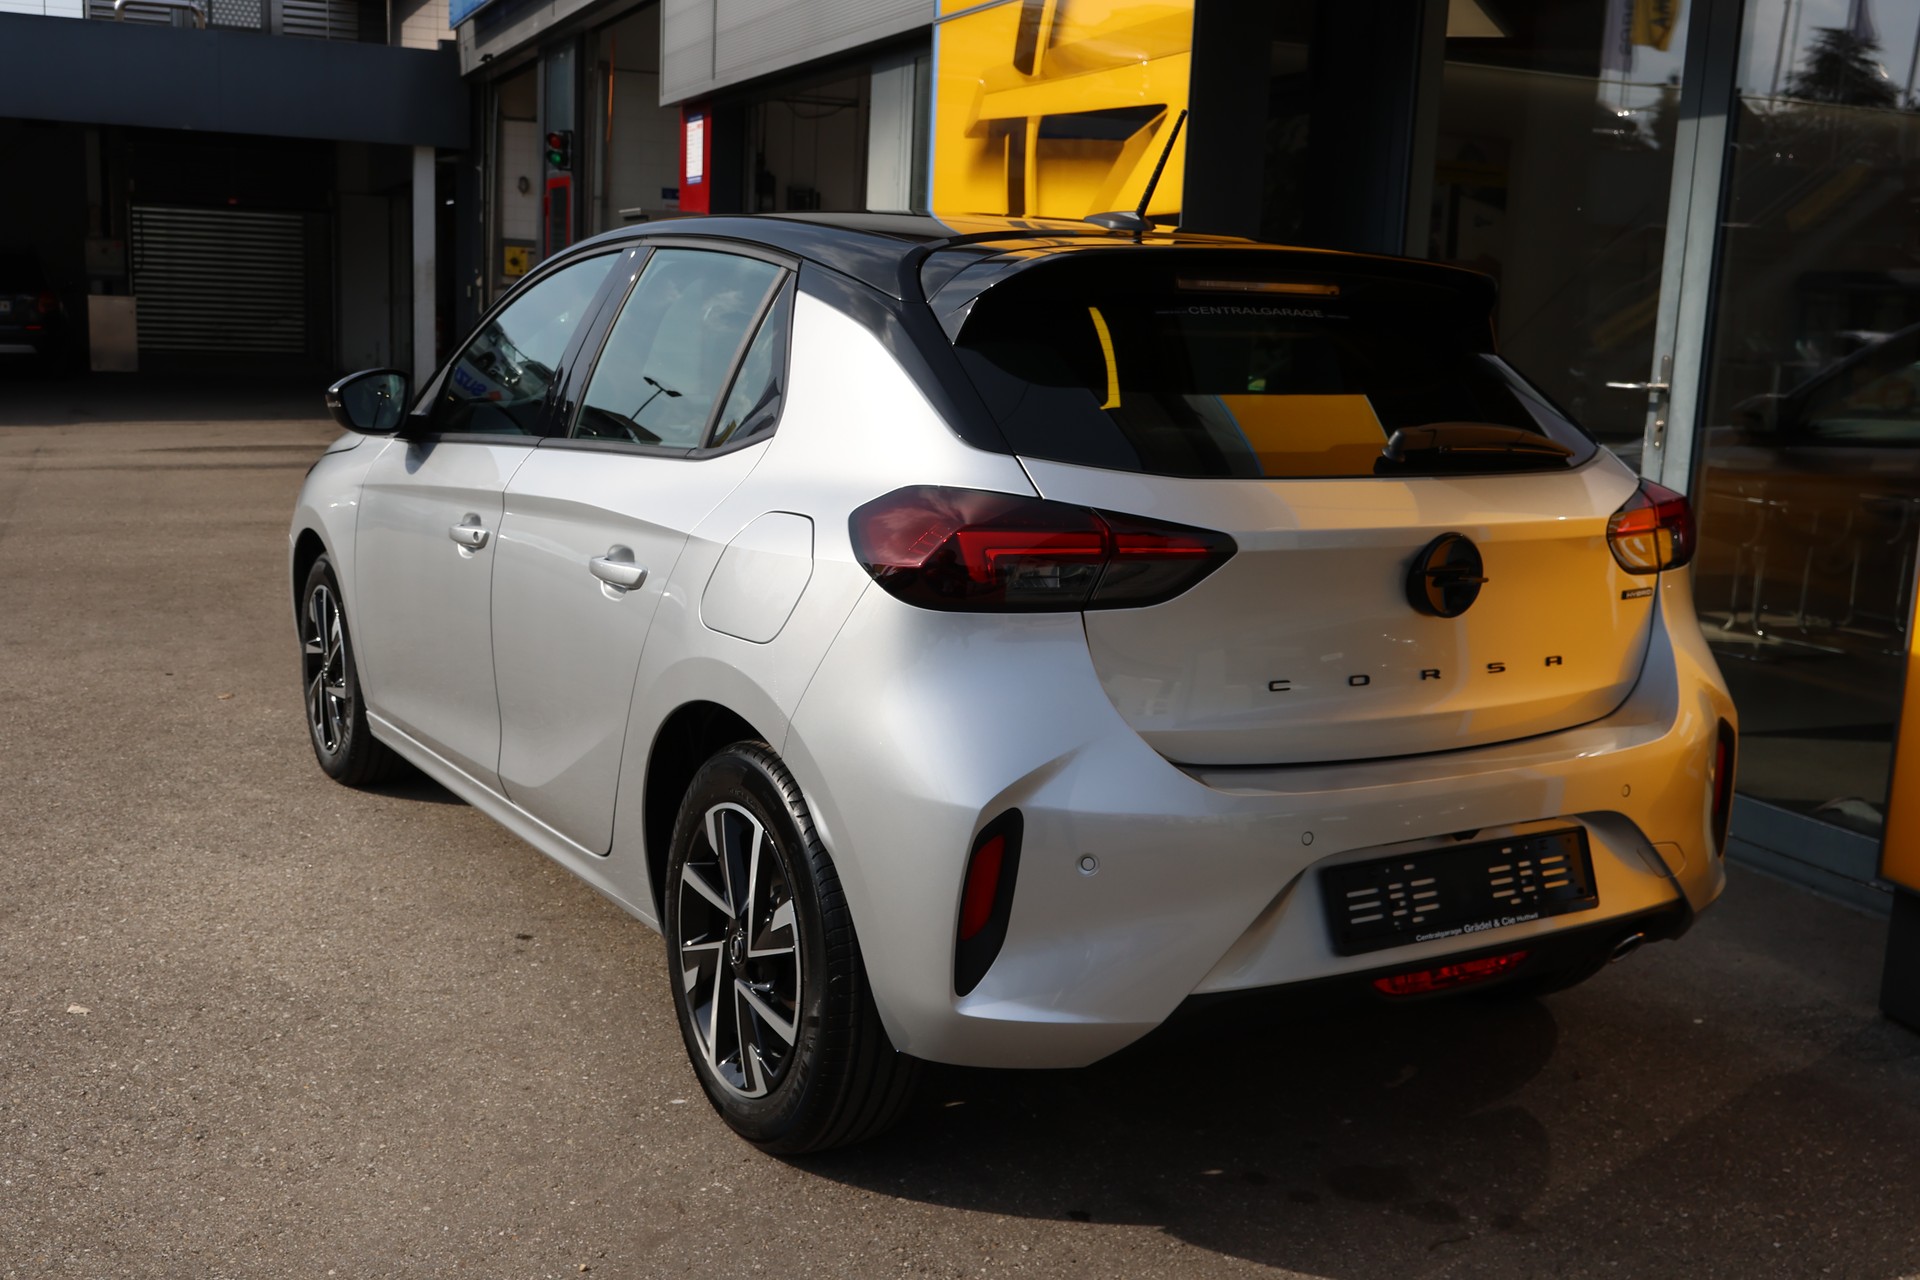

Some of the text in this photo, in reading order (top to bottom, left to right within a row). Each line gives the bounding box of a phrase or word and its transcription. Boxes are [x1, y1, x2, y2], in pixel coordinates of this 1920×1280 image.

[1188, 305, 1324, 318] CENTRALGARAGE
[1267, 654, 1563, 693] CORSA
[1415, 928, 1463, 942] Centralgarage
[1463, 920, 1493, 934] Grädel
[1493, 918, 1501, 928] &
[1501, 915, 1516, 926] Cie
